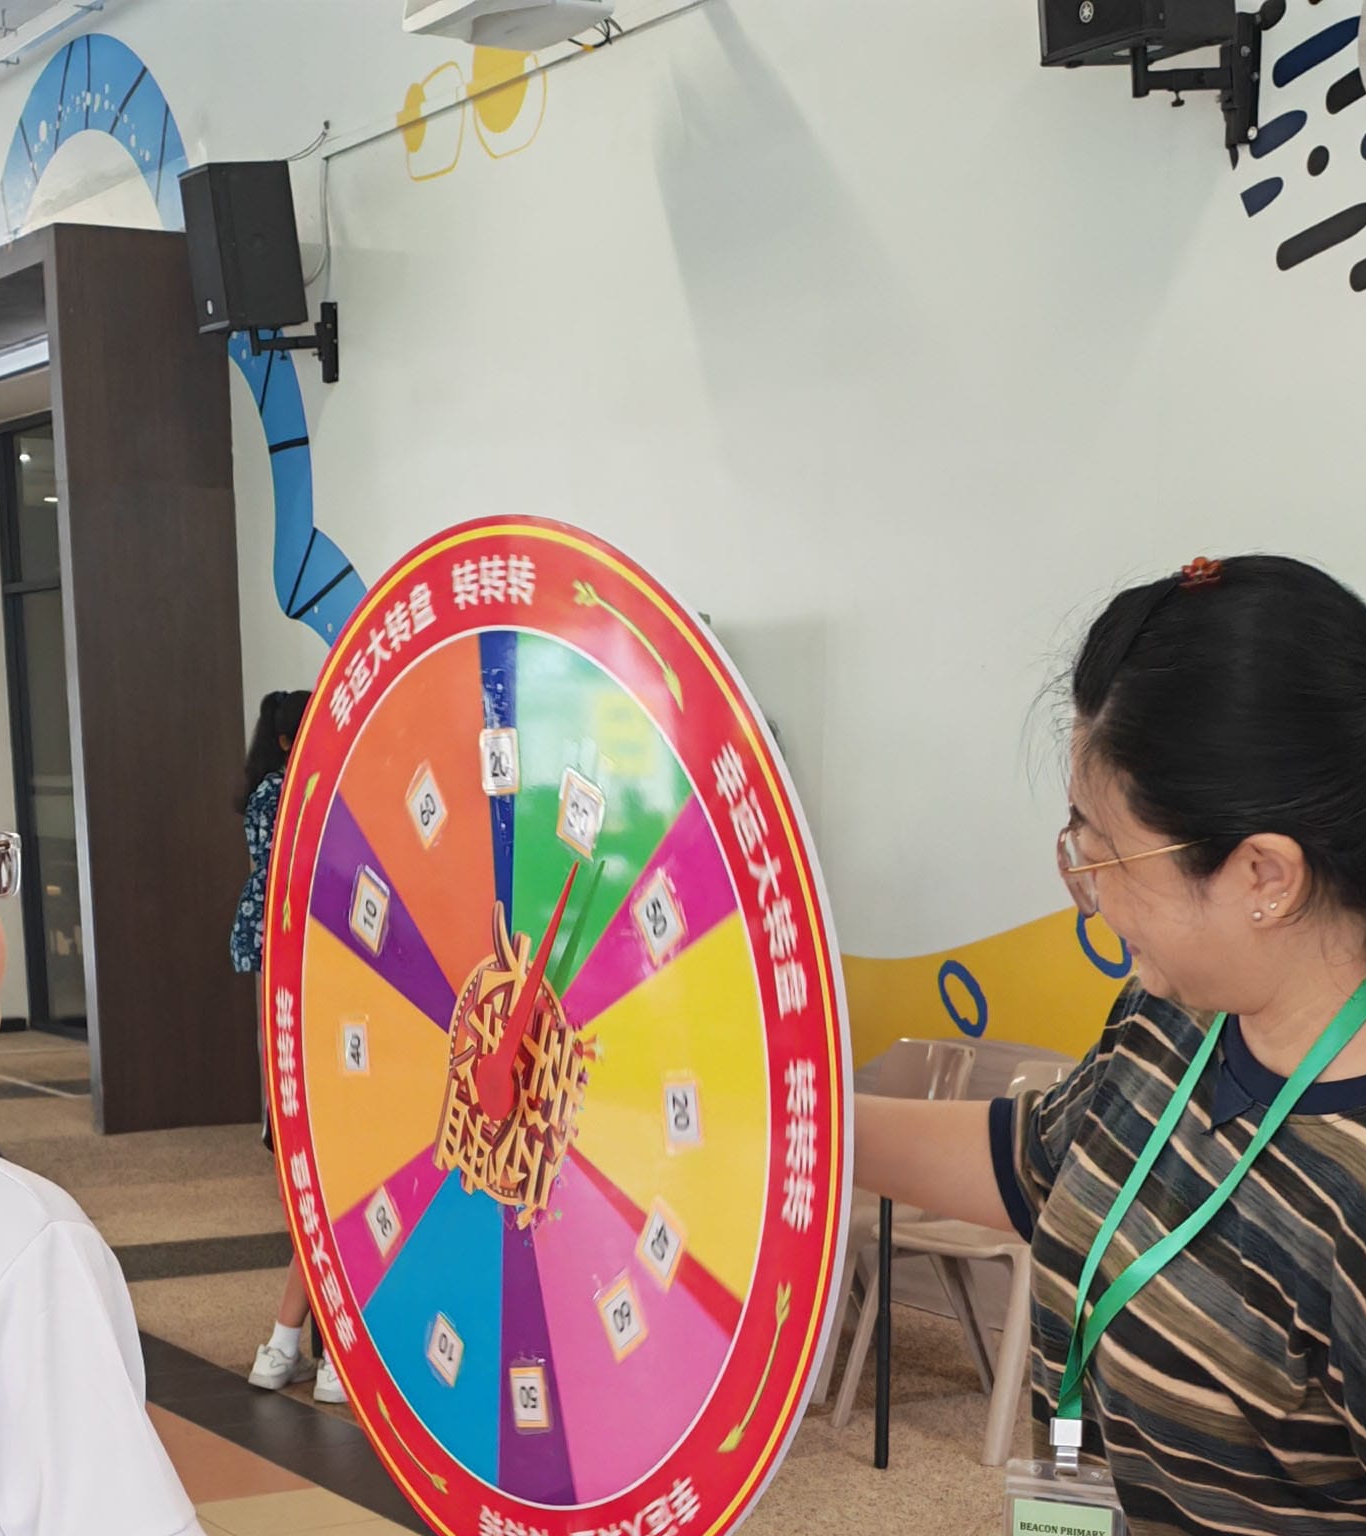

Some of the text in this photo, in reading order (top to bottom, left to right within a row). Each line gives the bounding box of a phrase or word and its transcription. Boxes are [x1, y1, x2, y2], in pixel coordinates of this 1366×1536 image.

[451, 554, 537, 611] 转转转
[363, 898, 378, 931] 10
[671, 1091, 691, 1132] 20
[1019, 1521, 1058, 1535] BEACON
